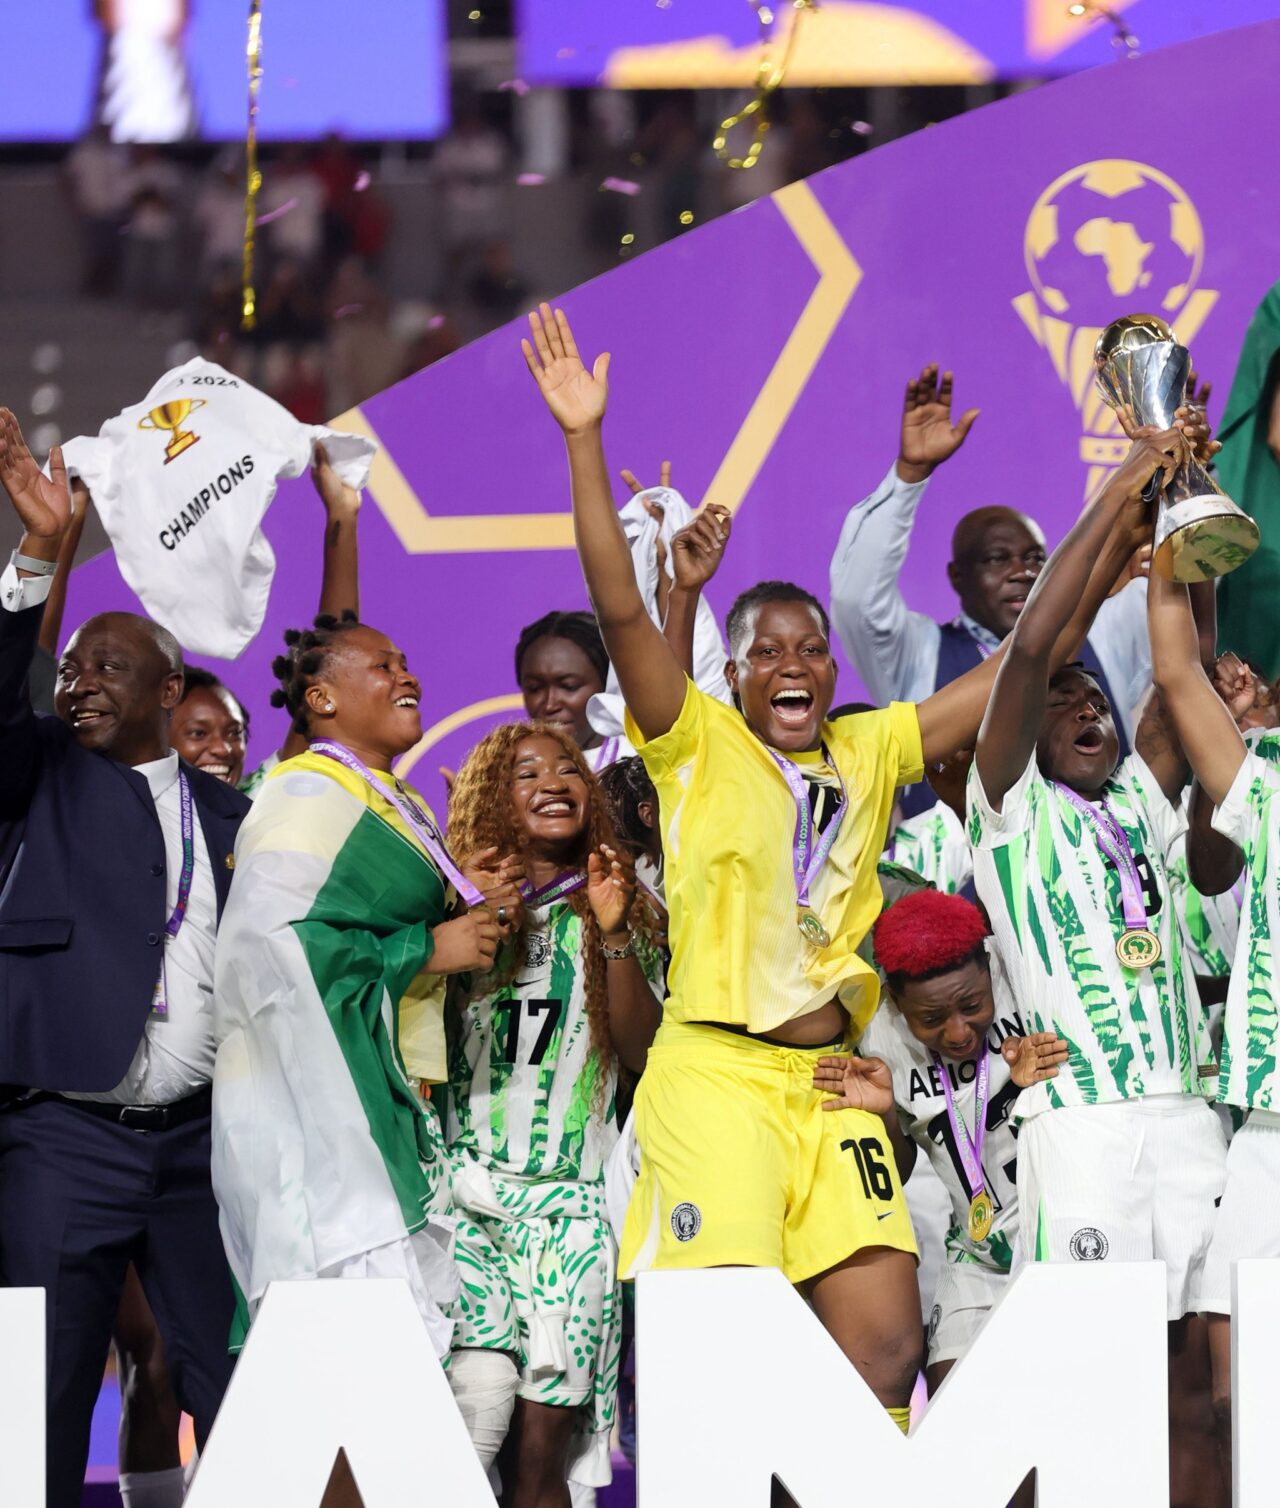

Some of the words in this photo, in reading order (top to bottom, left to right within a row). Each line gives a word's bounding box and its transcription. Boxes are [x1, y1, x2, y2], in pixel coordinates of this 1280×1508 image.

[158, 454, 256, 552] CHAMPIONS
[798, 799, 808, 839] MOROCCO
[498, 998, 562, 1066] 17
[908, 1011, 1026, 1102] ABIOUN
[840, 1137, 894, 1201] 16
